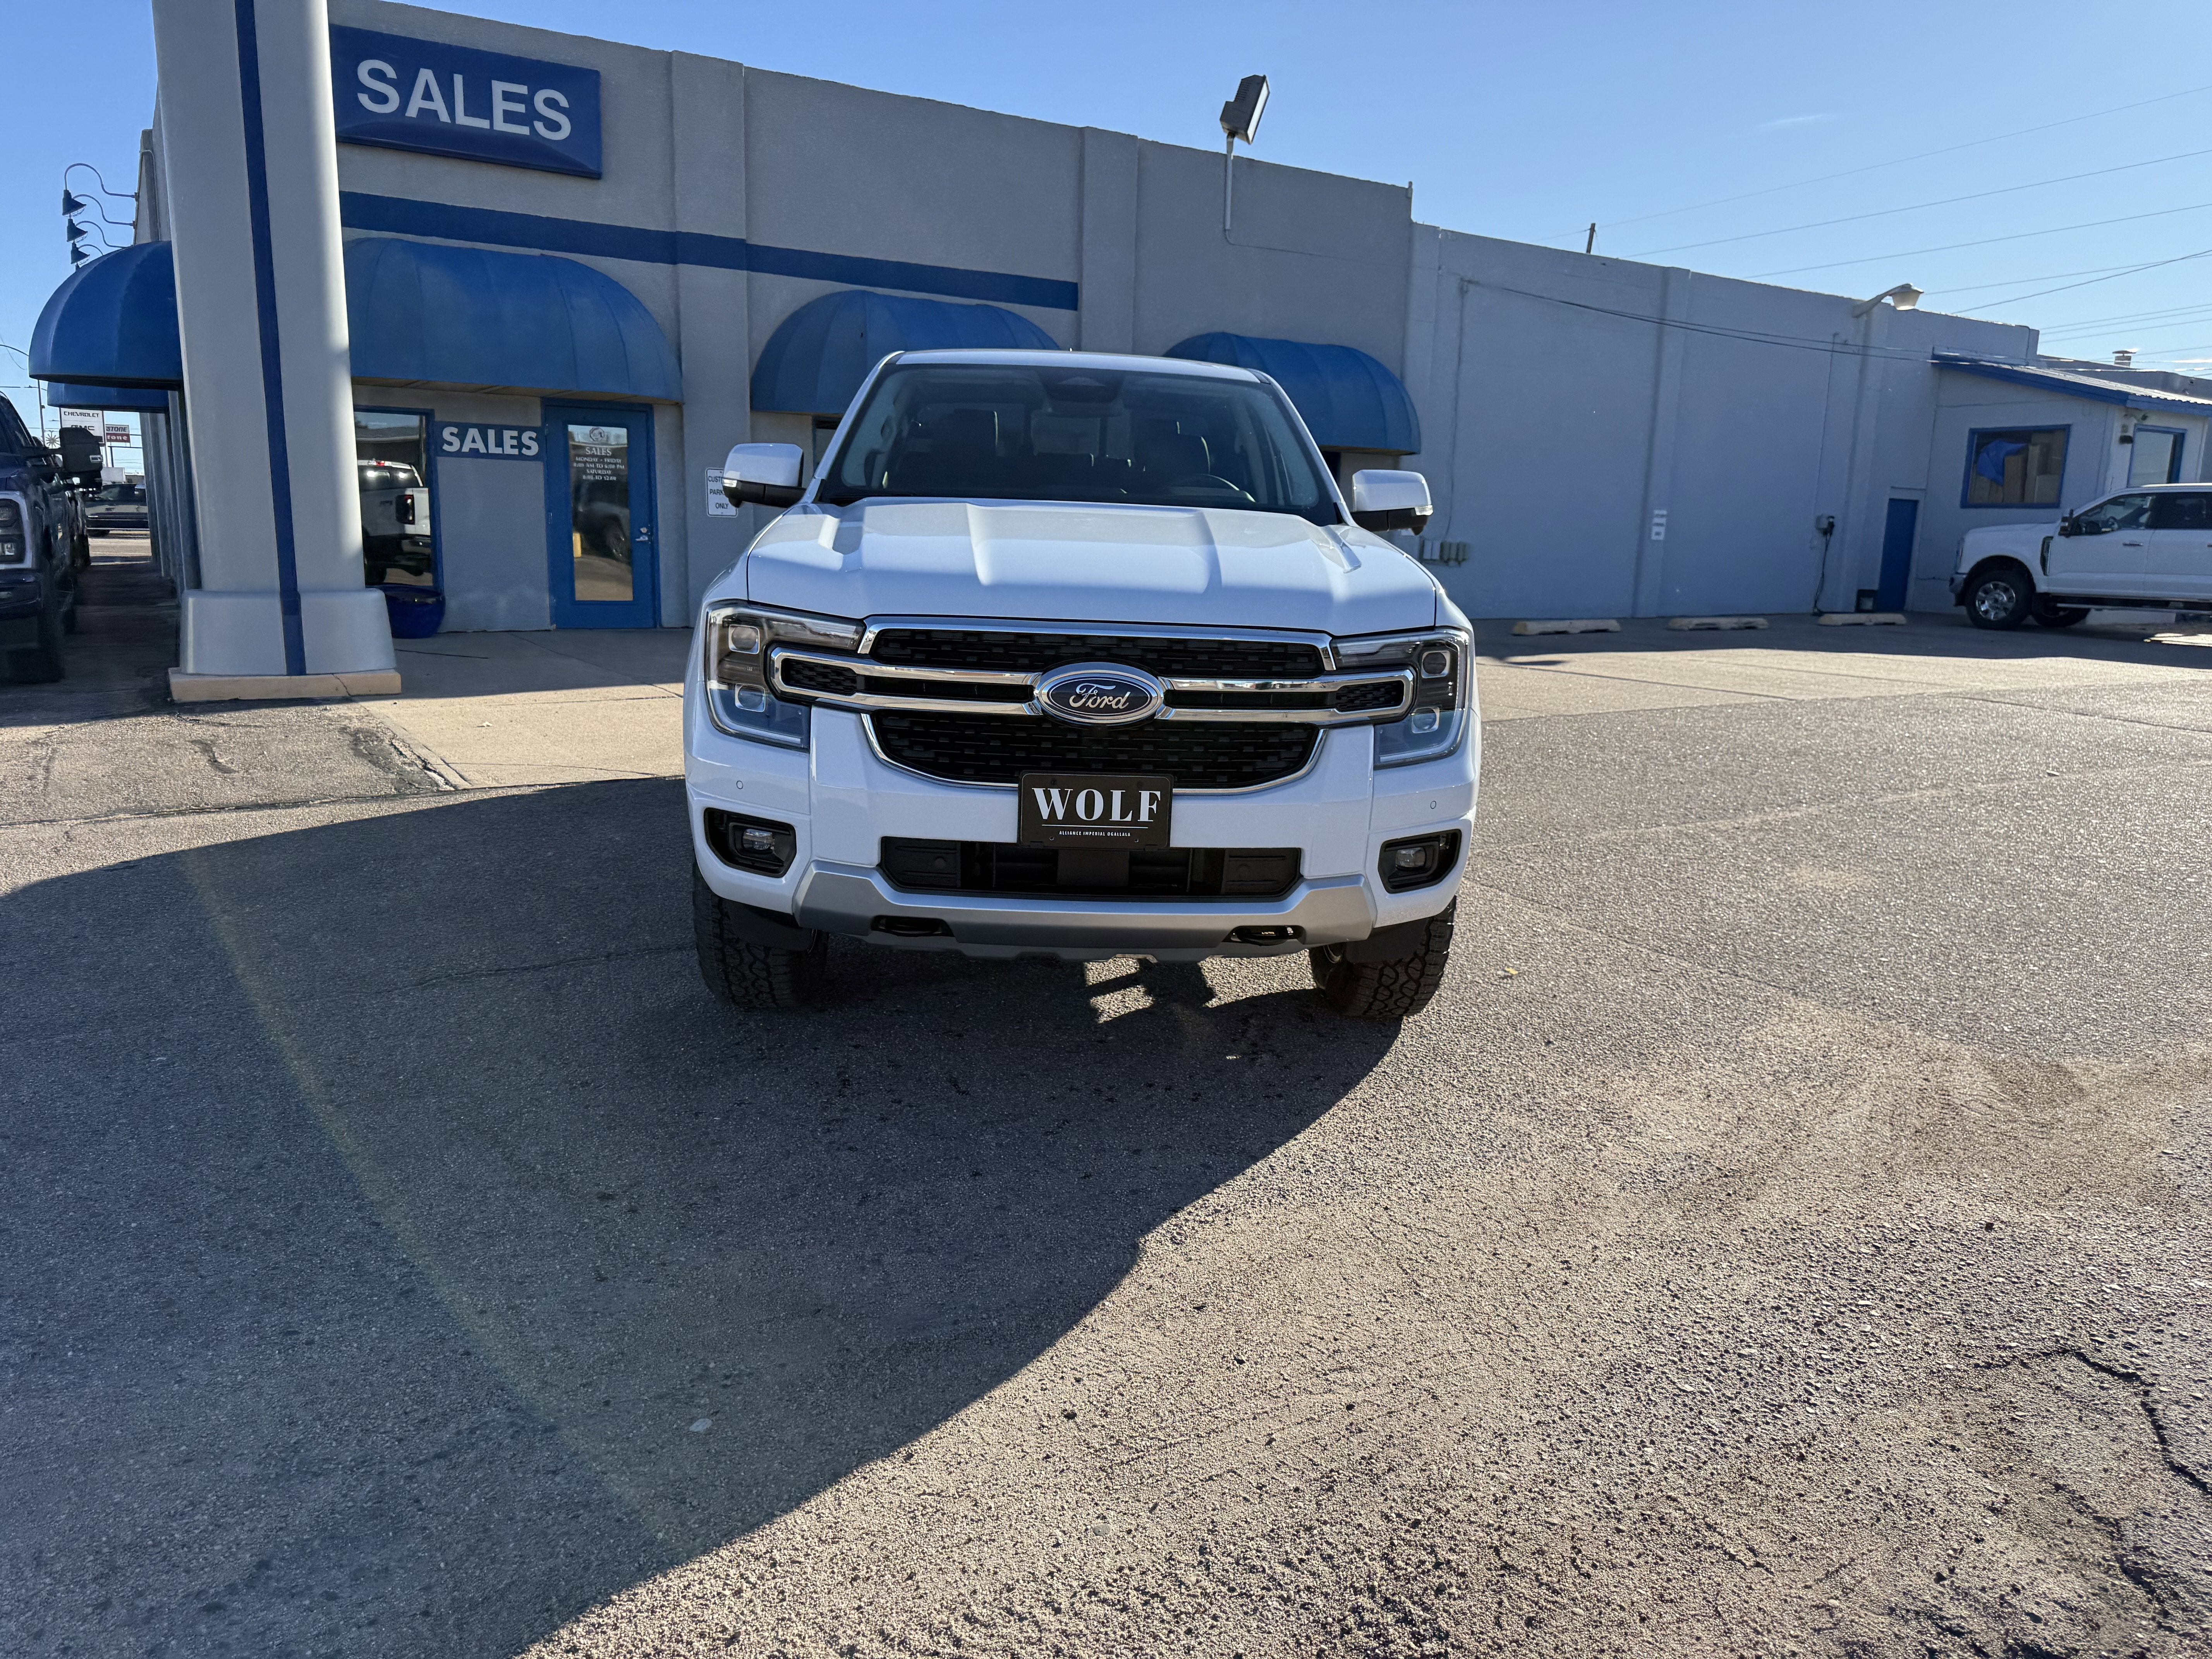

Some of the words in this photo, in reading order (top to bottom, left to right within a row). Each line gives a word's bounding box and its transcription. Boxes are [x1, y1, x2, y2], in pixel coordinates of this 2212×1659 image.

[357, 59, 571, 141] SALES
[442, 427, 539, 456] SALES
[586, 447, 612, 456] SALES
[1069, 682, 1131, 710] Ford
[1032, 788, 1161, 822] WOLF
